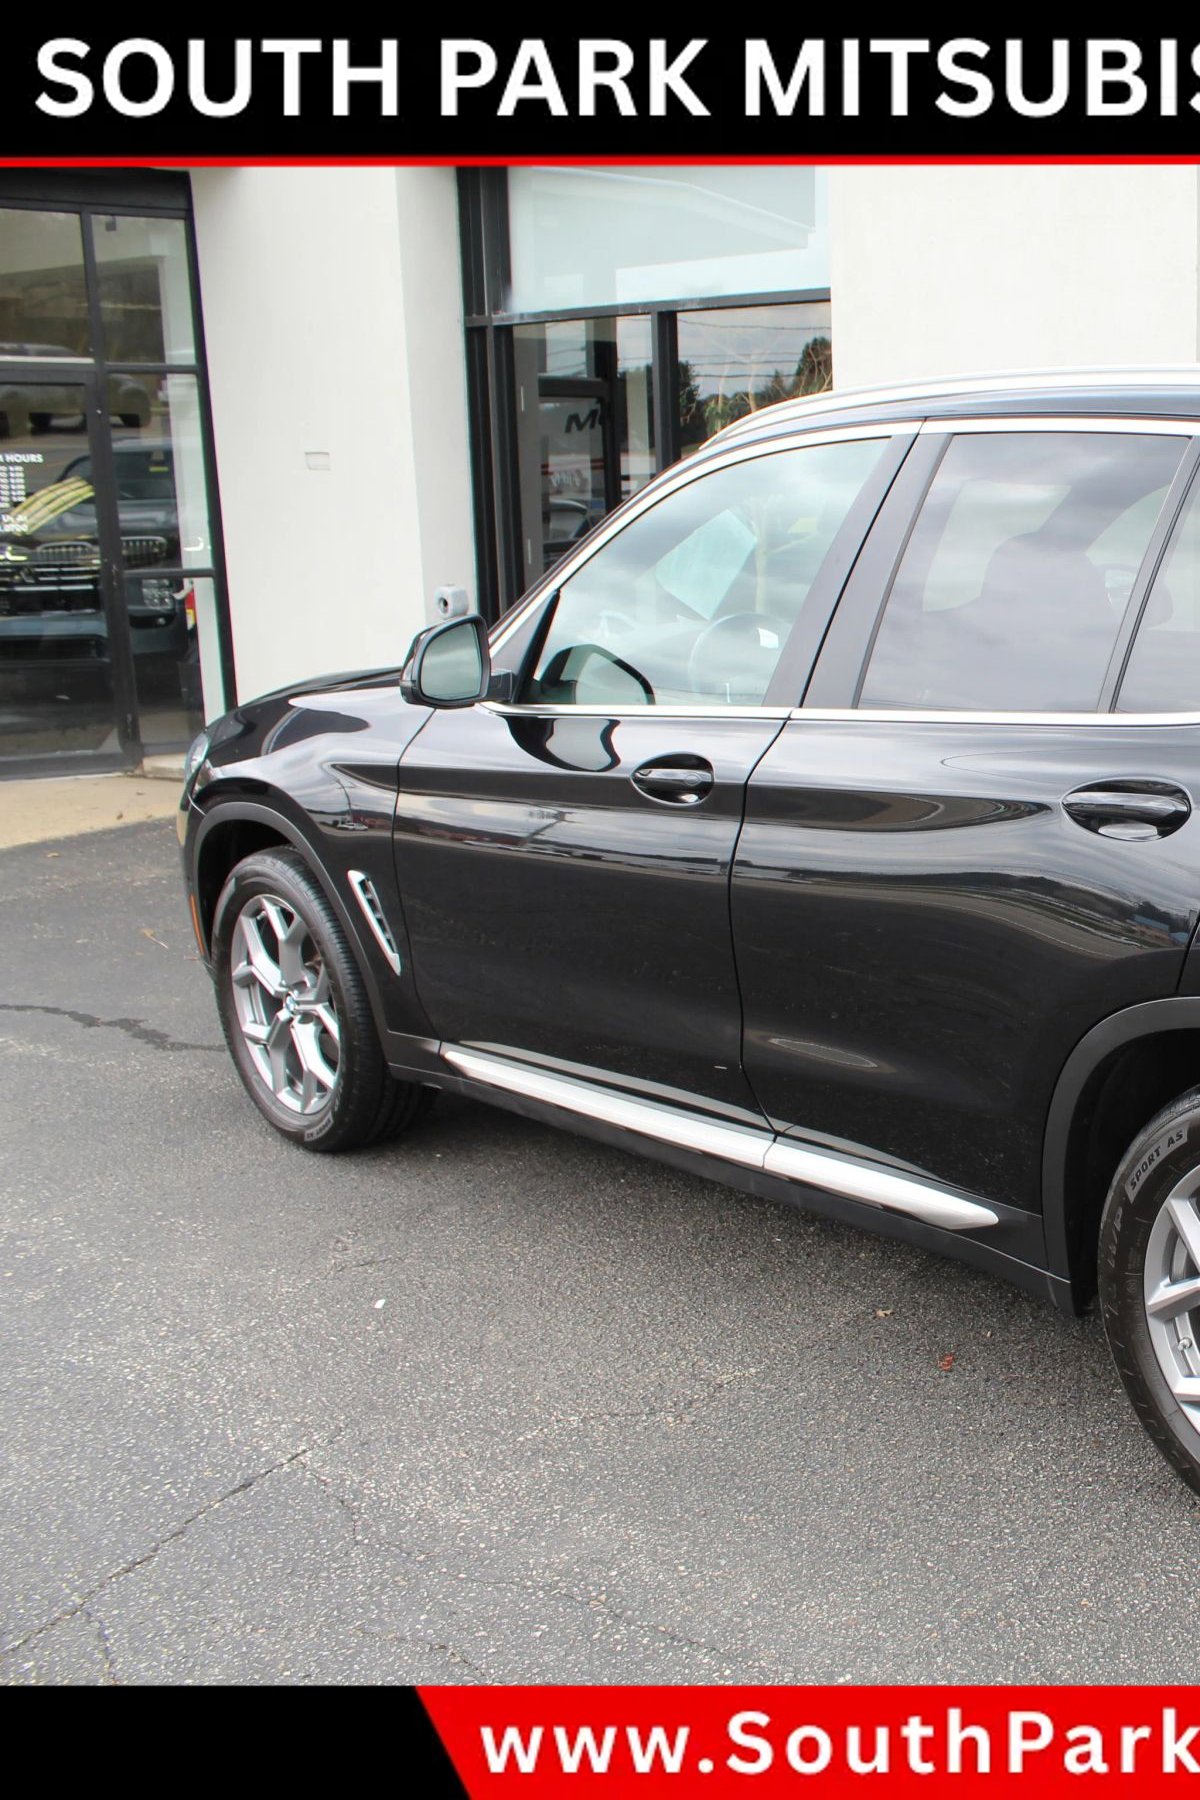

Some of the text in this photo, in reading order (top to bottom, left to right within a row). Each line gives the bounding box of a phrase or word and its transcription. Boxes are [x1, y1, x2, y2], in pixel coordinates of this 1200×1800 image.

[5, 453, 44, 463] HOURS
[1129, 1129, 1184, 1191] SPORT AS
